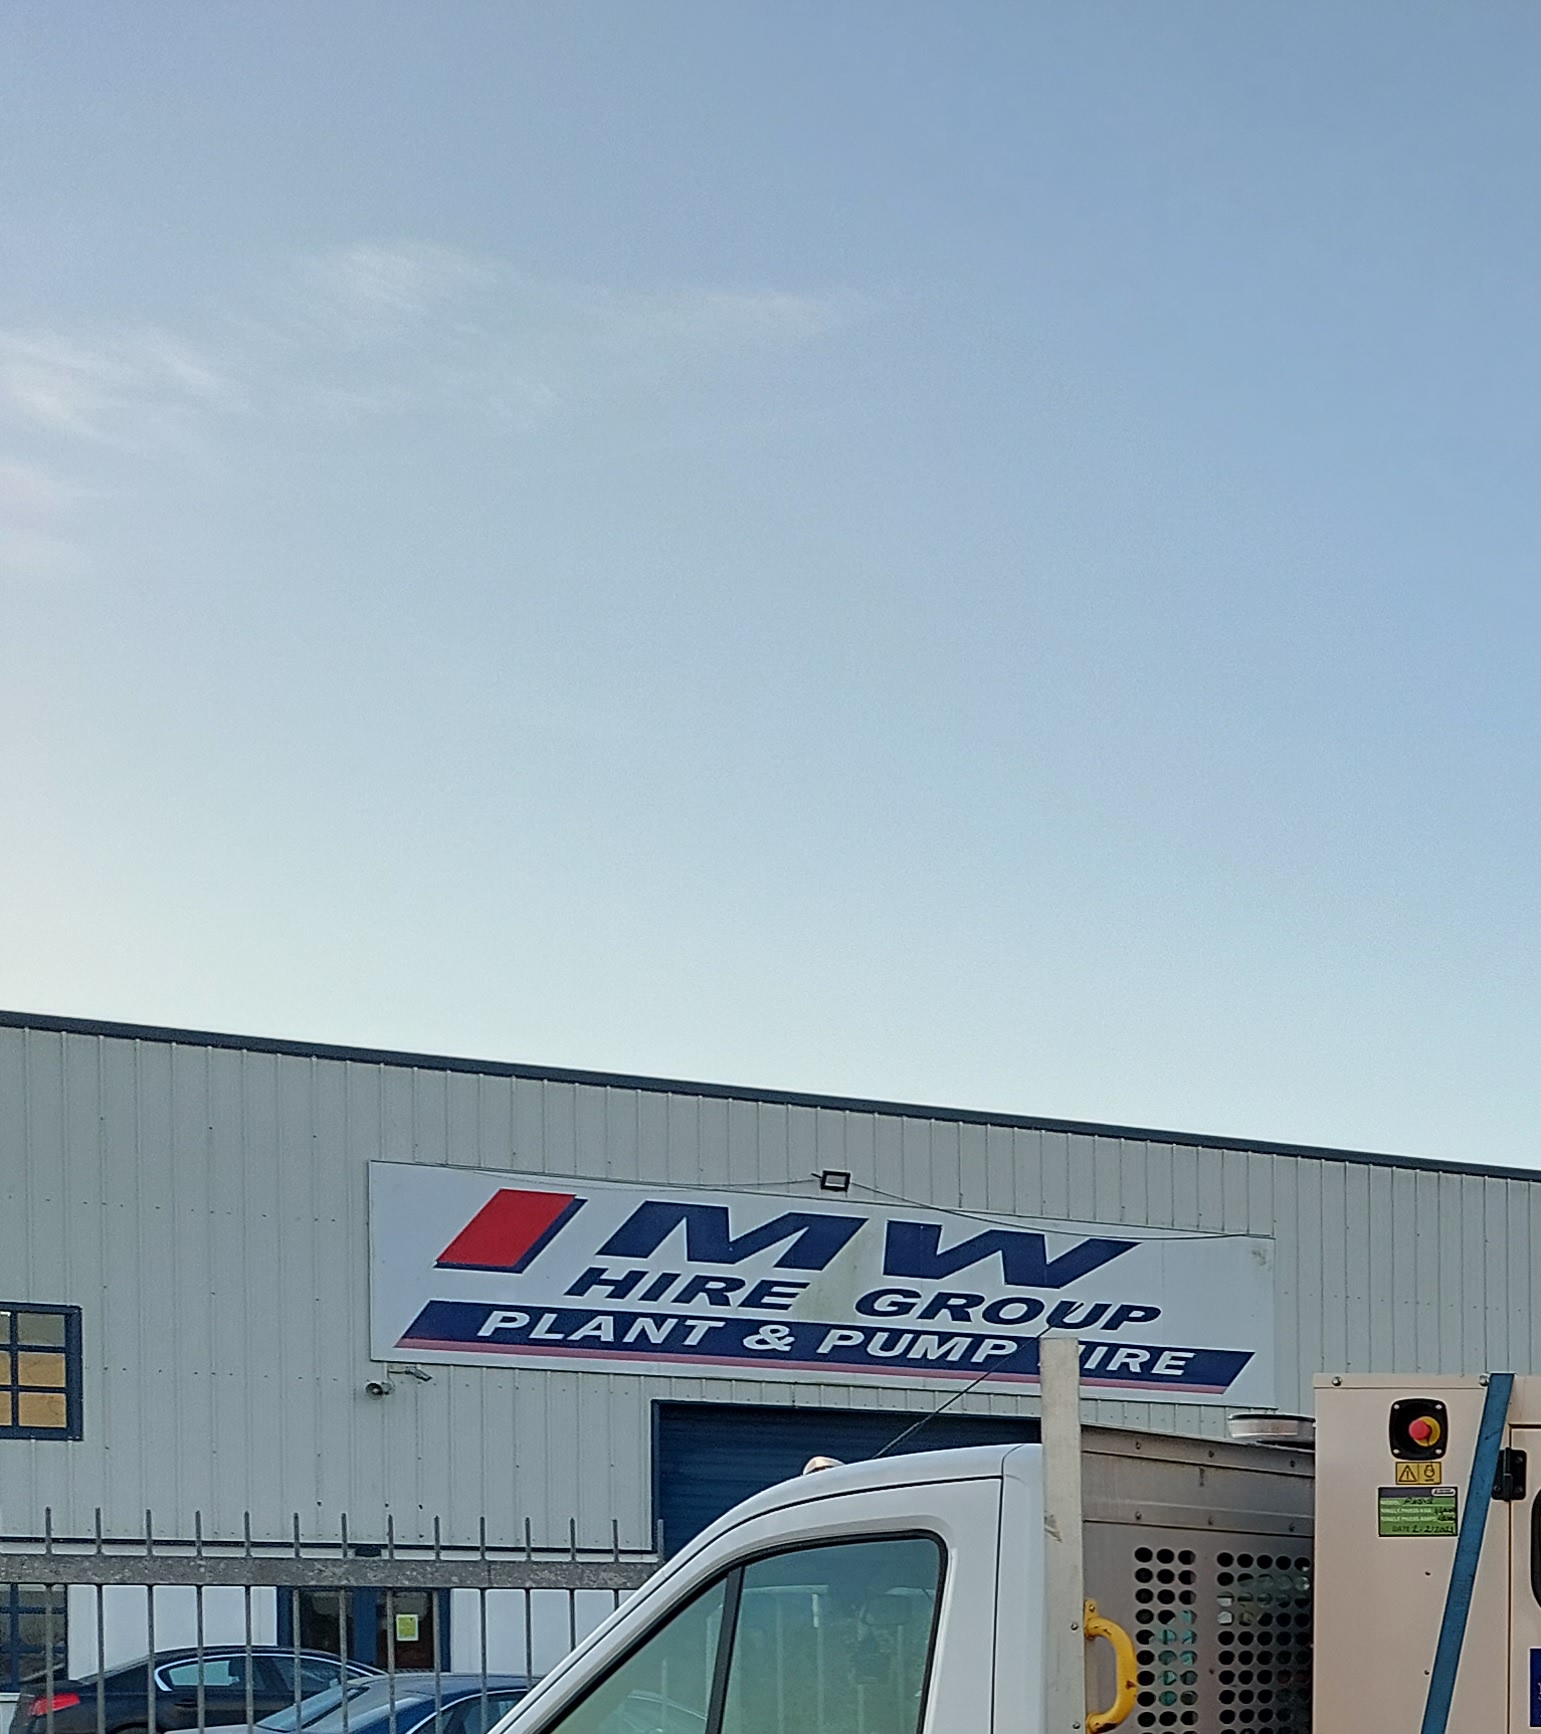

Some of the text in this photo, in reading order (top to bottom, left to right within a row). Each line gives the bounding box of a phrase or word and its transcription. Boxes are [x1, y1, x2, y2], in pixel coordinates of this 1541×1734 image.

[594, 1200, 1144, 1290] MW
[563, 1267, 1162, 1331] HIRE GROUP
[477, 1309, 727, 1346] PLANT
[742, 1324, 796, 1351] &
[815, 1326, 1019, 1366] PUMP
